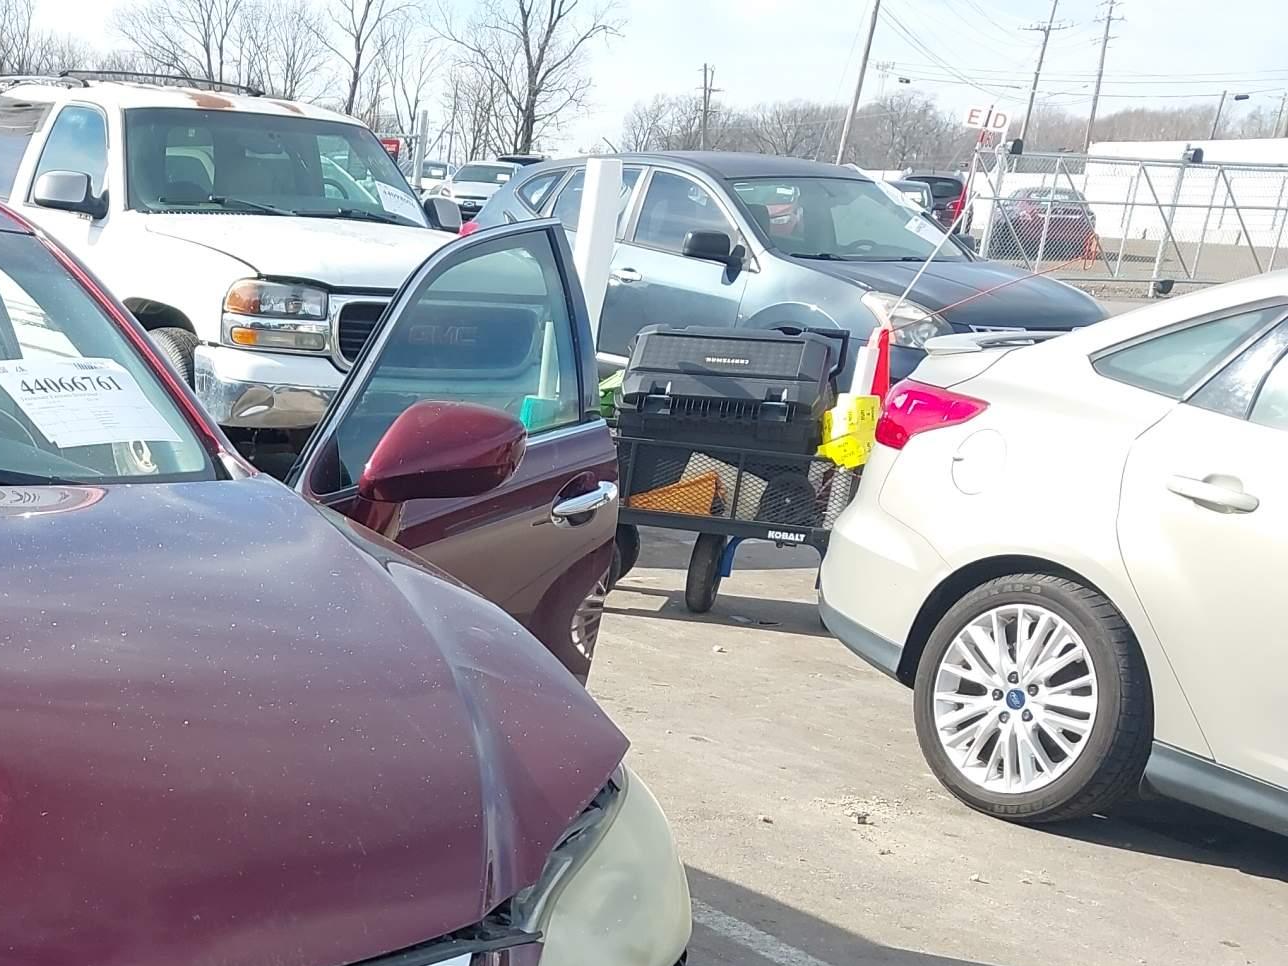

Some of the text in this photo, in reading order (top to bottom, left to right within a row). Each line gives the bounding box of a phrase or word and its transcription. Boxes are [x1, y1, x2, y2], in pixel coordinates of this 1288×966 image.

[968, 109, 1007, 128] E D
[20, 375, 123, 395] 44066761
[768, 530, 806, 541] KOBALT
